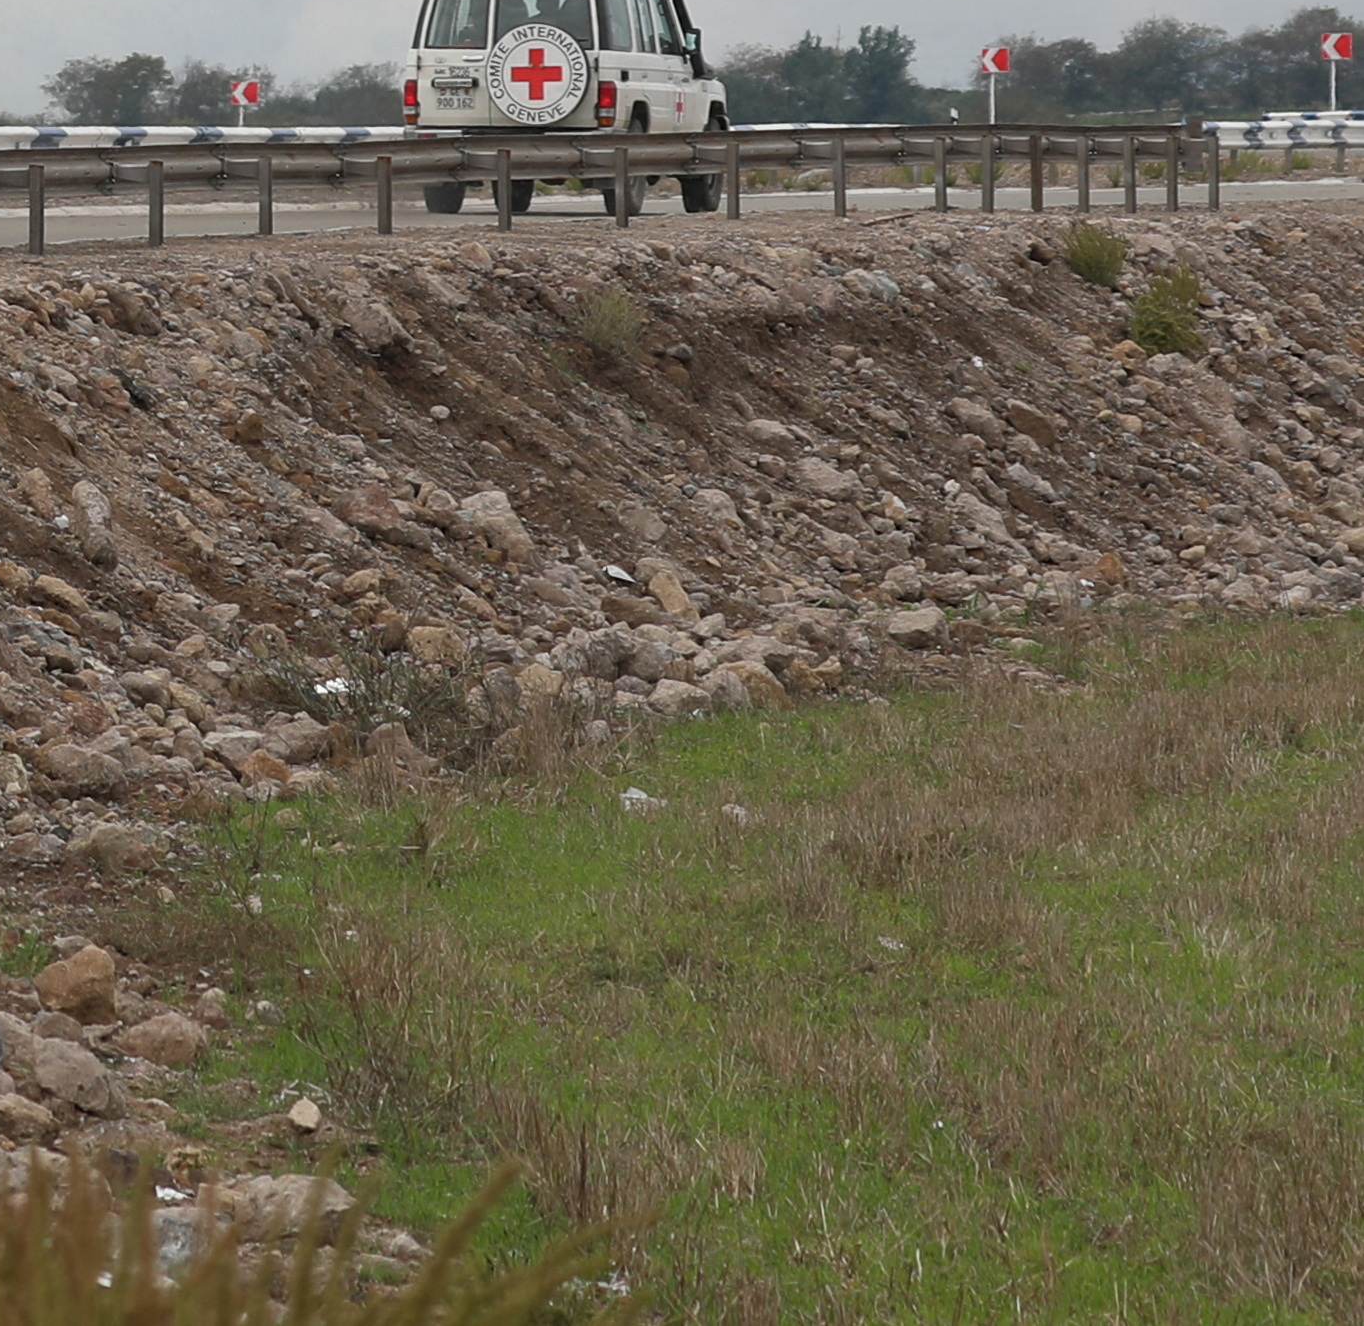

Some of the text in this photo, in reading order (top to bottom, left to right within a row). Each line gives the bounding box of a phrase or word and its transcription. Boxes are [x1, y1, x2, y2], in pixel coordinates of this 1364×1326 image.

[489, 26, 584, 100] COMITE INTERNATIONAL
[506, 103, 567, 123] GENEVE
